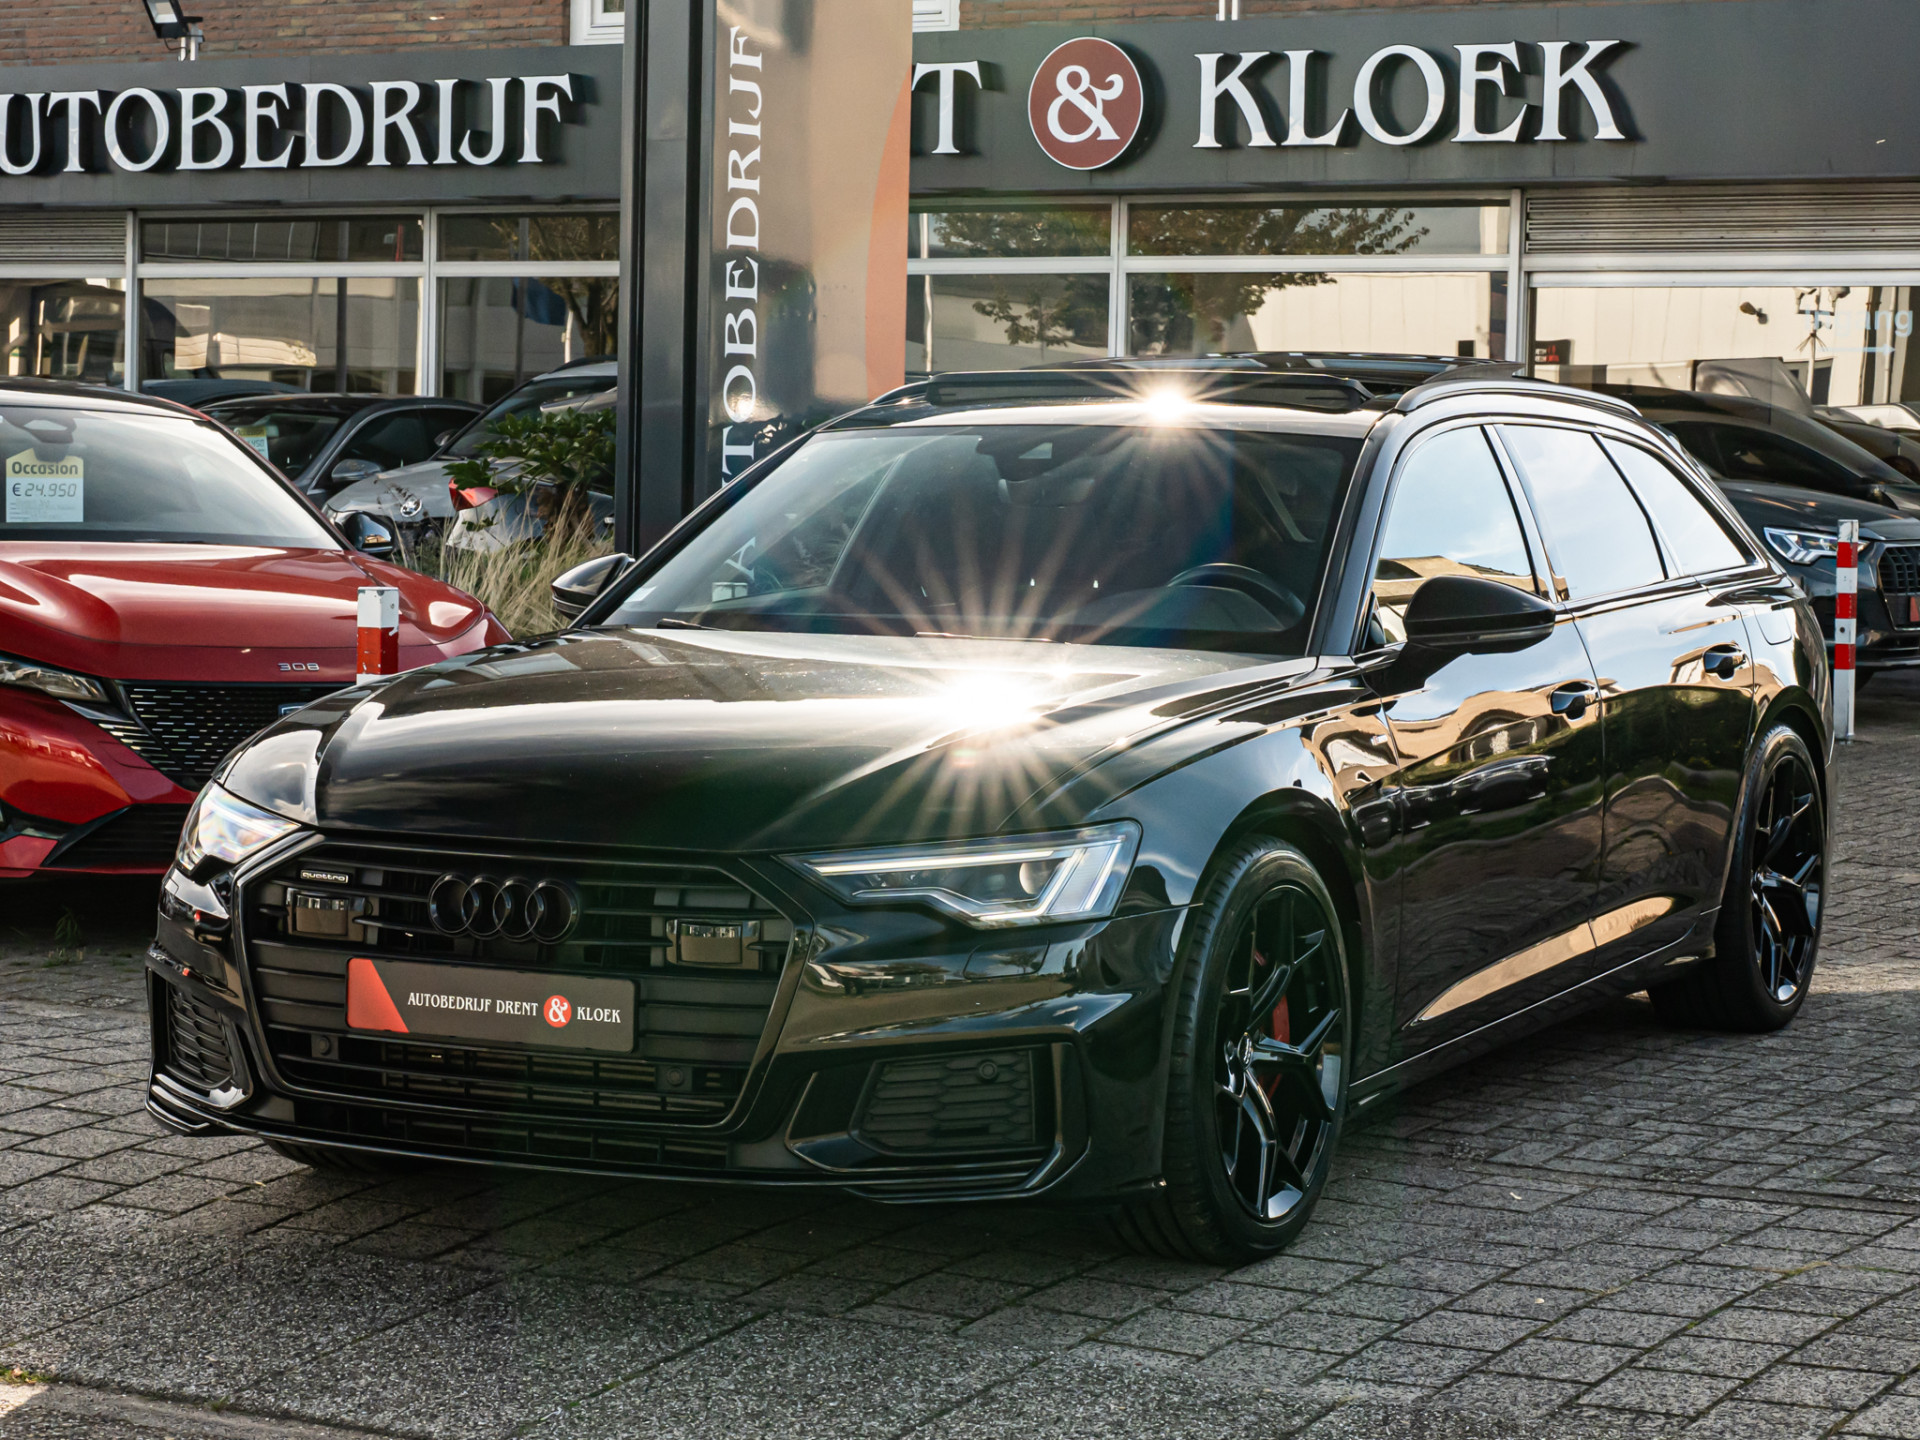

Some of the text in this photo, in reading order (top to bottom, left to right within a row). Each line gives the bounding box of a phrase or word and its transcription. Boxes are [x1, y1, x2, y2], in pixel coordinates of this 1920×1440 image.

[1046, 65, 1124, 144] &
[1192, 40, 1626, 149] KLOEK
[11, 461, 79, 475] Occasion
[24, 482, 77, 498] 24.950
[277, 662, 320, 671] 308
[302, 872, 346, 882] quattro
[407, 992, 621, 1024] AUTOBEDRIJF DRENT & KLOEK
